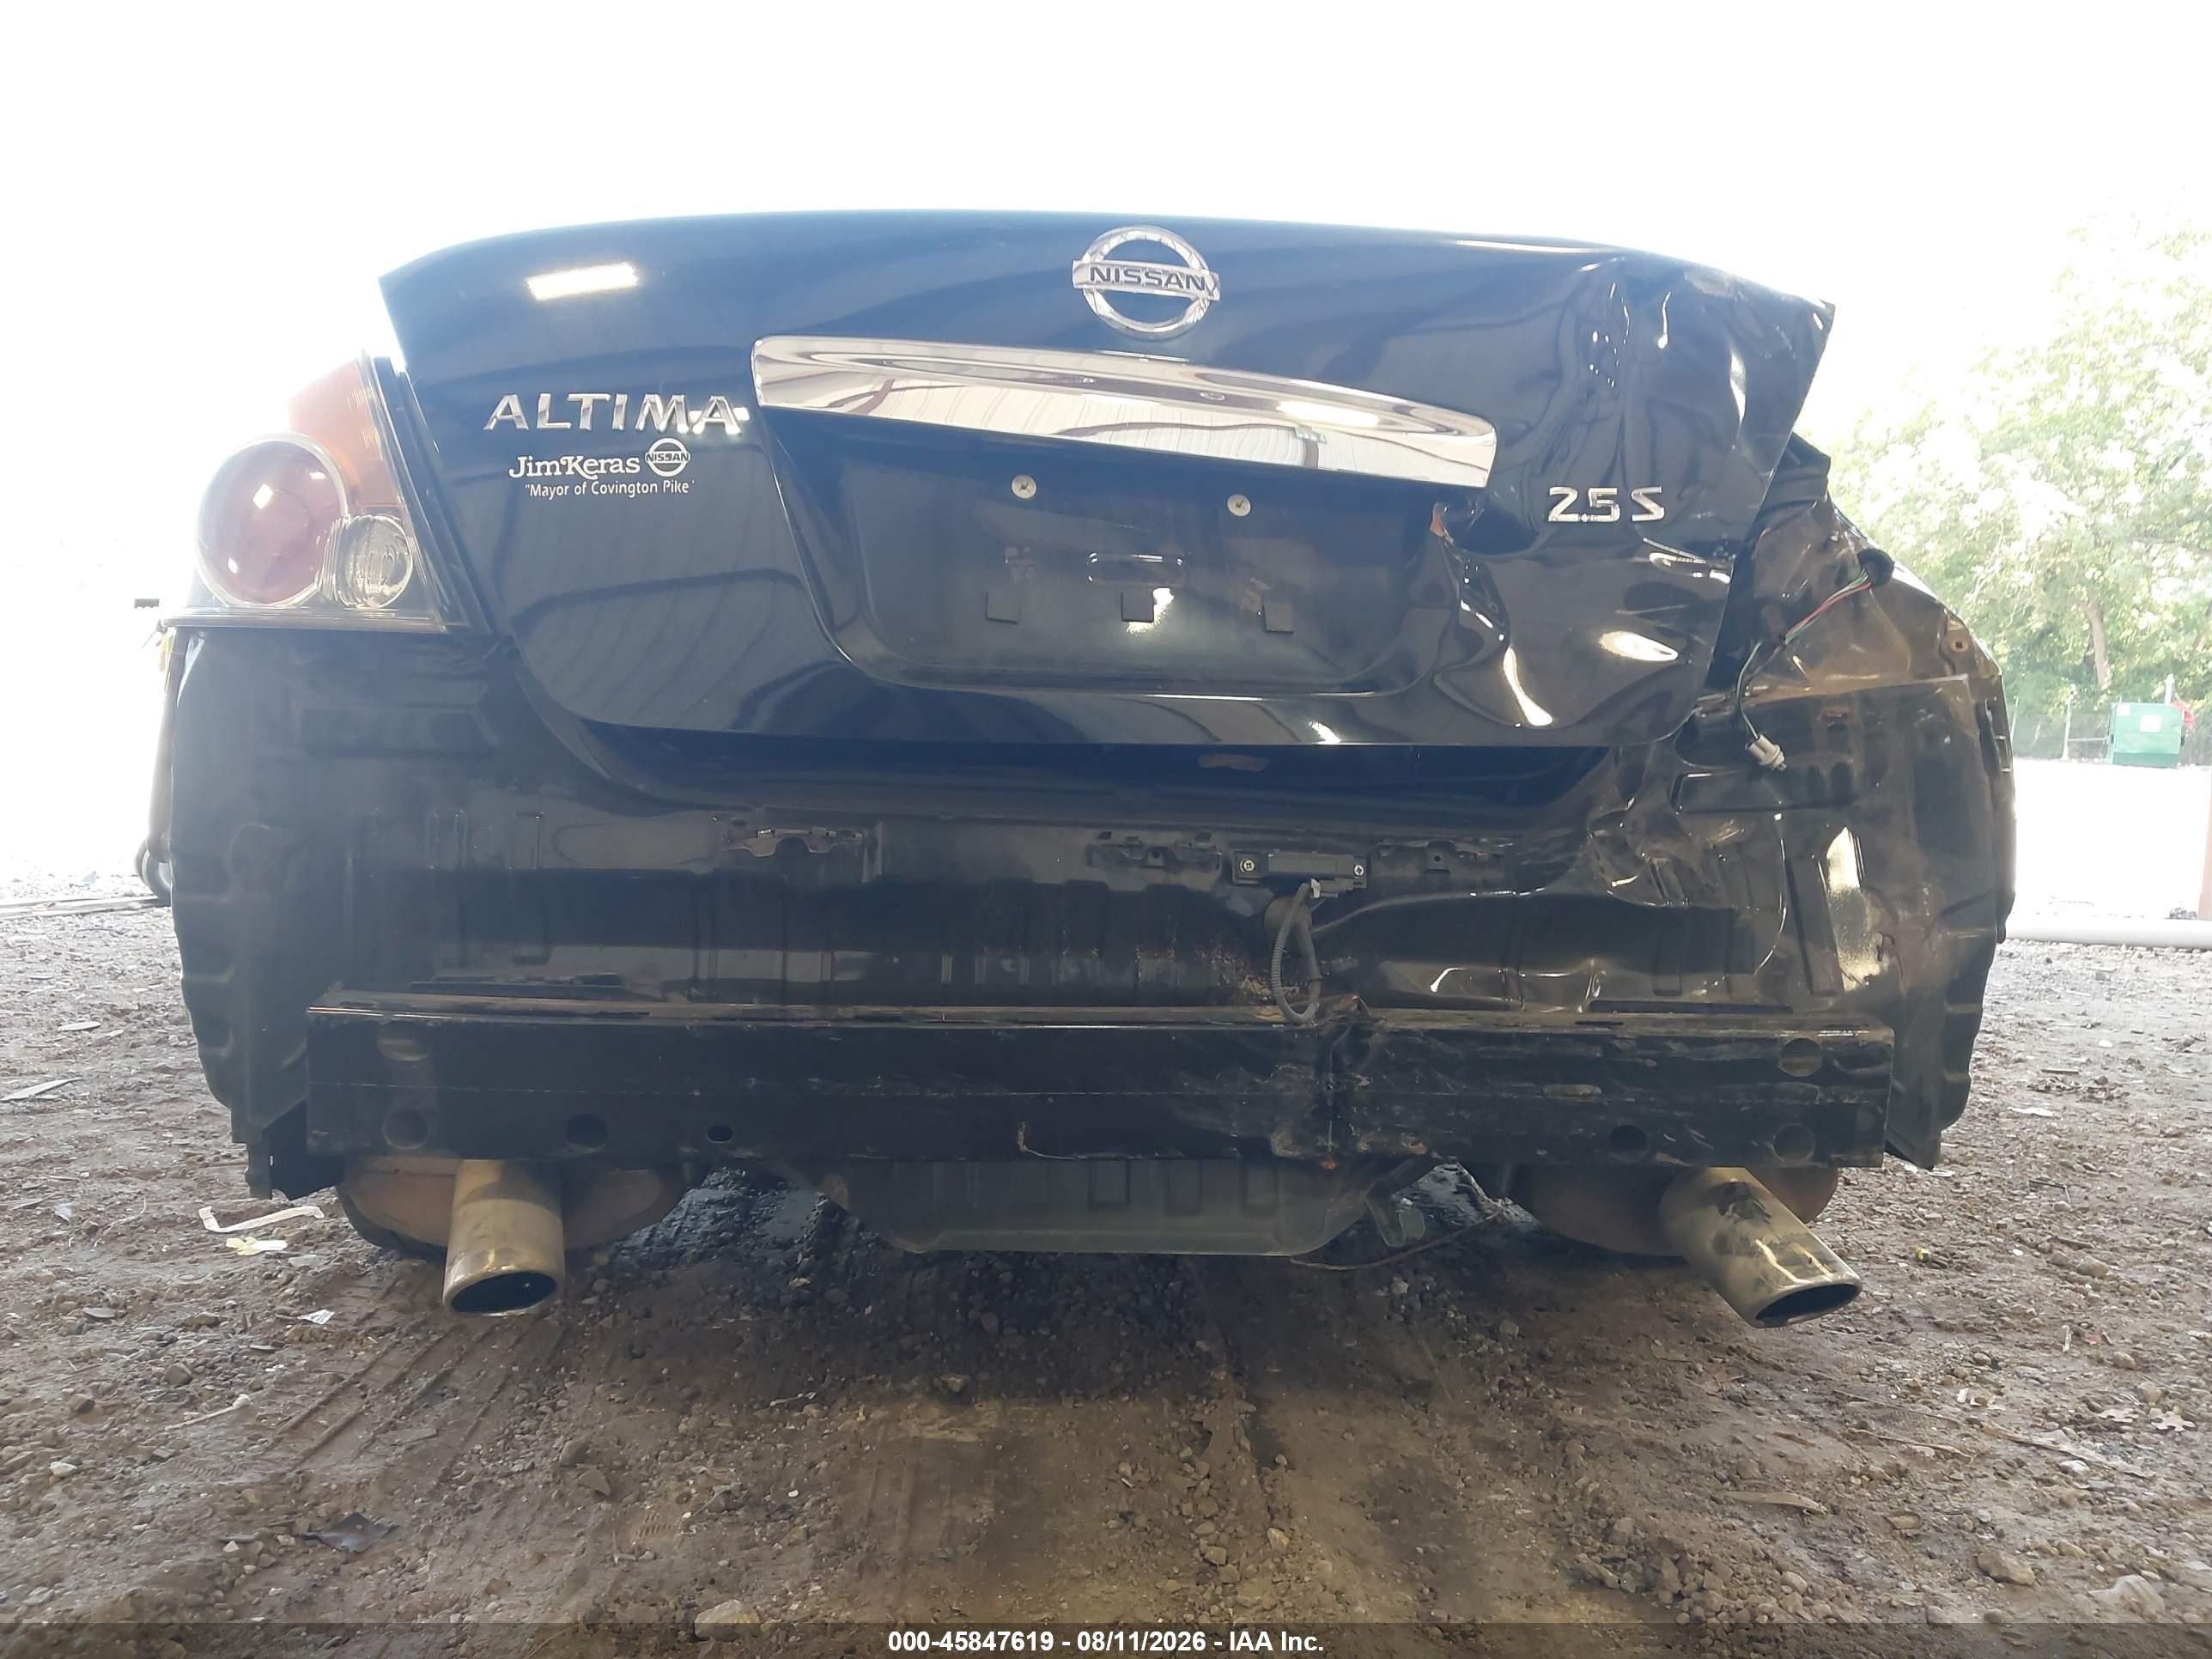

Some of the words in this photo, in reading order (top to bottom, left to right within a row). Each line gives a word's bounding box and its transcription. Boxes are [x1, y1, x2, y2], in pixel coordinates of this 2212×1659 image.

[1090, 266, 1206, 291] NISSAN
[483, 393, 741, 434] ALTIMA
[646, 452, 690, 462] NISSAN
[574, 481, 587, 495] of
[591, 480, 659, 498] Covington
[1548, 486, 1621, 522] 2.5
[1632, 486, 1665, 522] S
